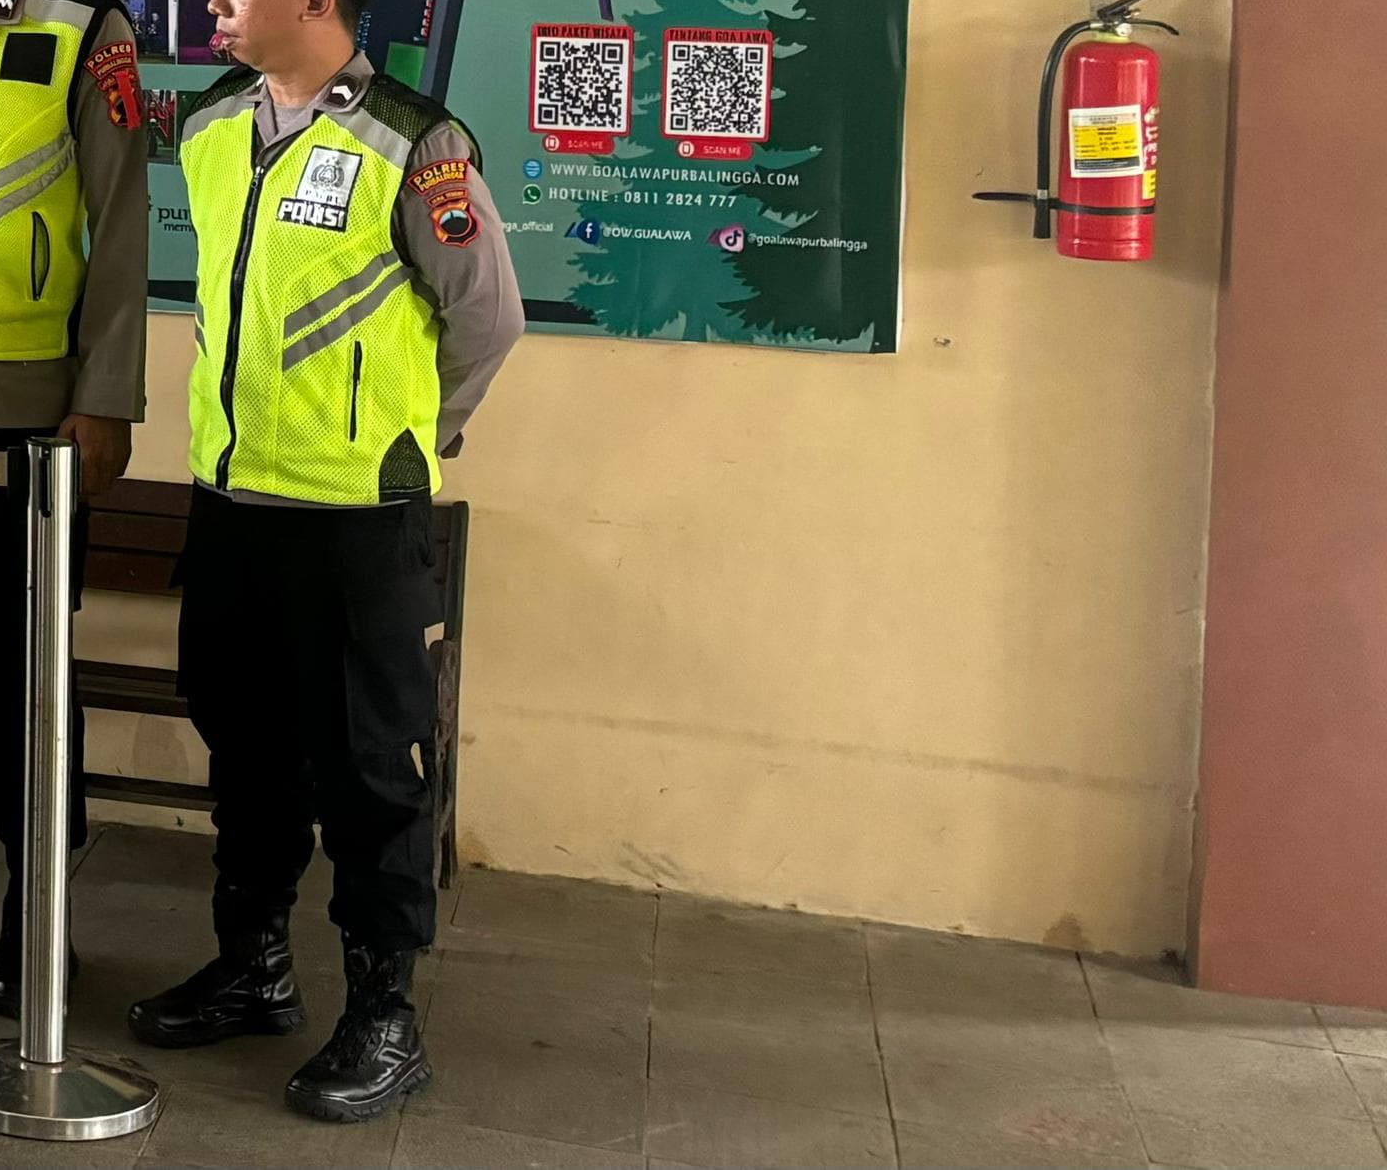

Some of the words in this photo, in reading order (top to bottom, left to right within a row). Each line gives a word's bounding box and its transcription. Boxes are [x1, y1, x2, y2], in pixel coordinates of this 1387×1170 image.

[87, 44, 131, 69] POLRES
[413, 162, 465, 186] POLRES
[550, 162, 800, 186] WWW.GOALAWAPURBALINGGA.COM
[548, 187, 609, 202] HOTLINE
[624, 191, 658, 204] 0811
[665, 192, 702, 206] 2824
[709, 194, 737, 207] 777
